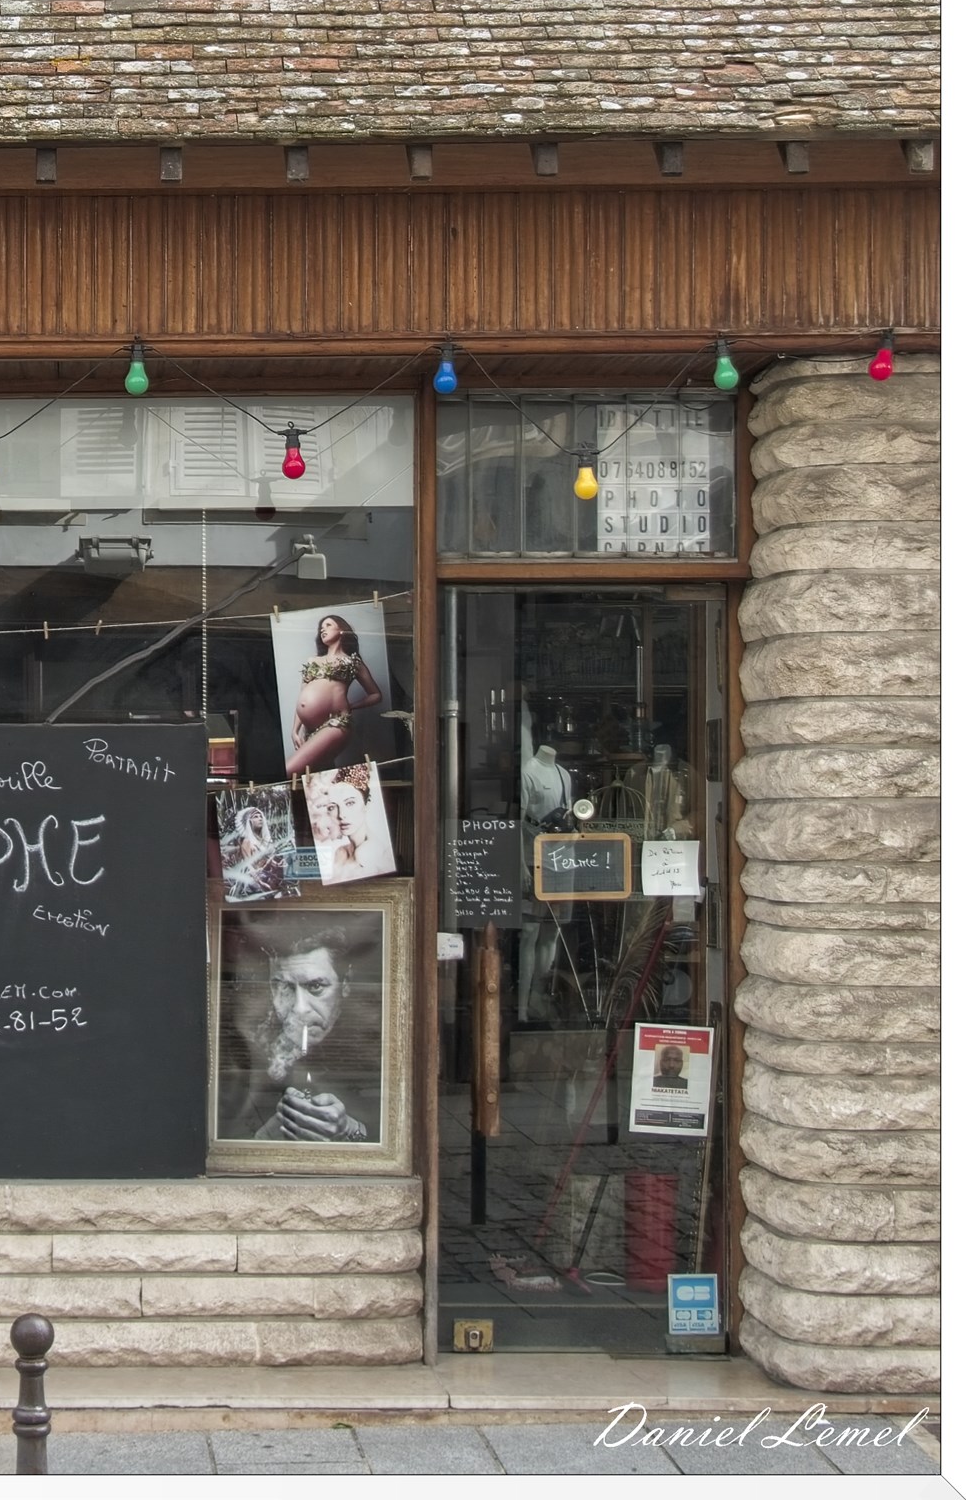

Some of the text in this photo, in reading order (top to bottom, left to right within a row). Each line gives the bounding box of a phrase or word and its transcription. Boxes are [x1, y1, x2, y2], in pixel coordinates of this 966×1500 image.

[605, 489, 706, 508] PHOTO
[605, 516, 707, 533] STUDIO
[462, 820, 515, 832] PHOTOS
[547, 845, 599, 872] Fermé
